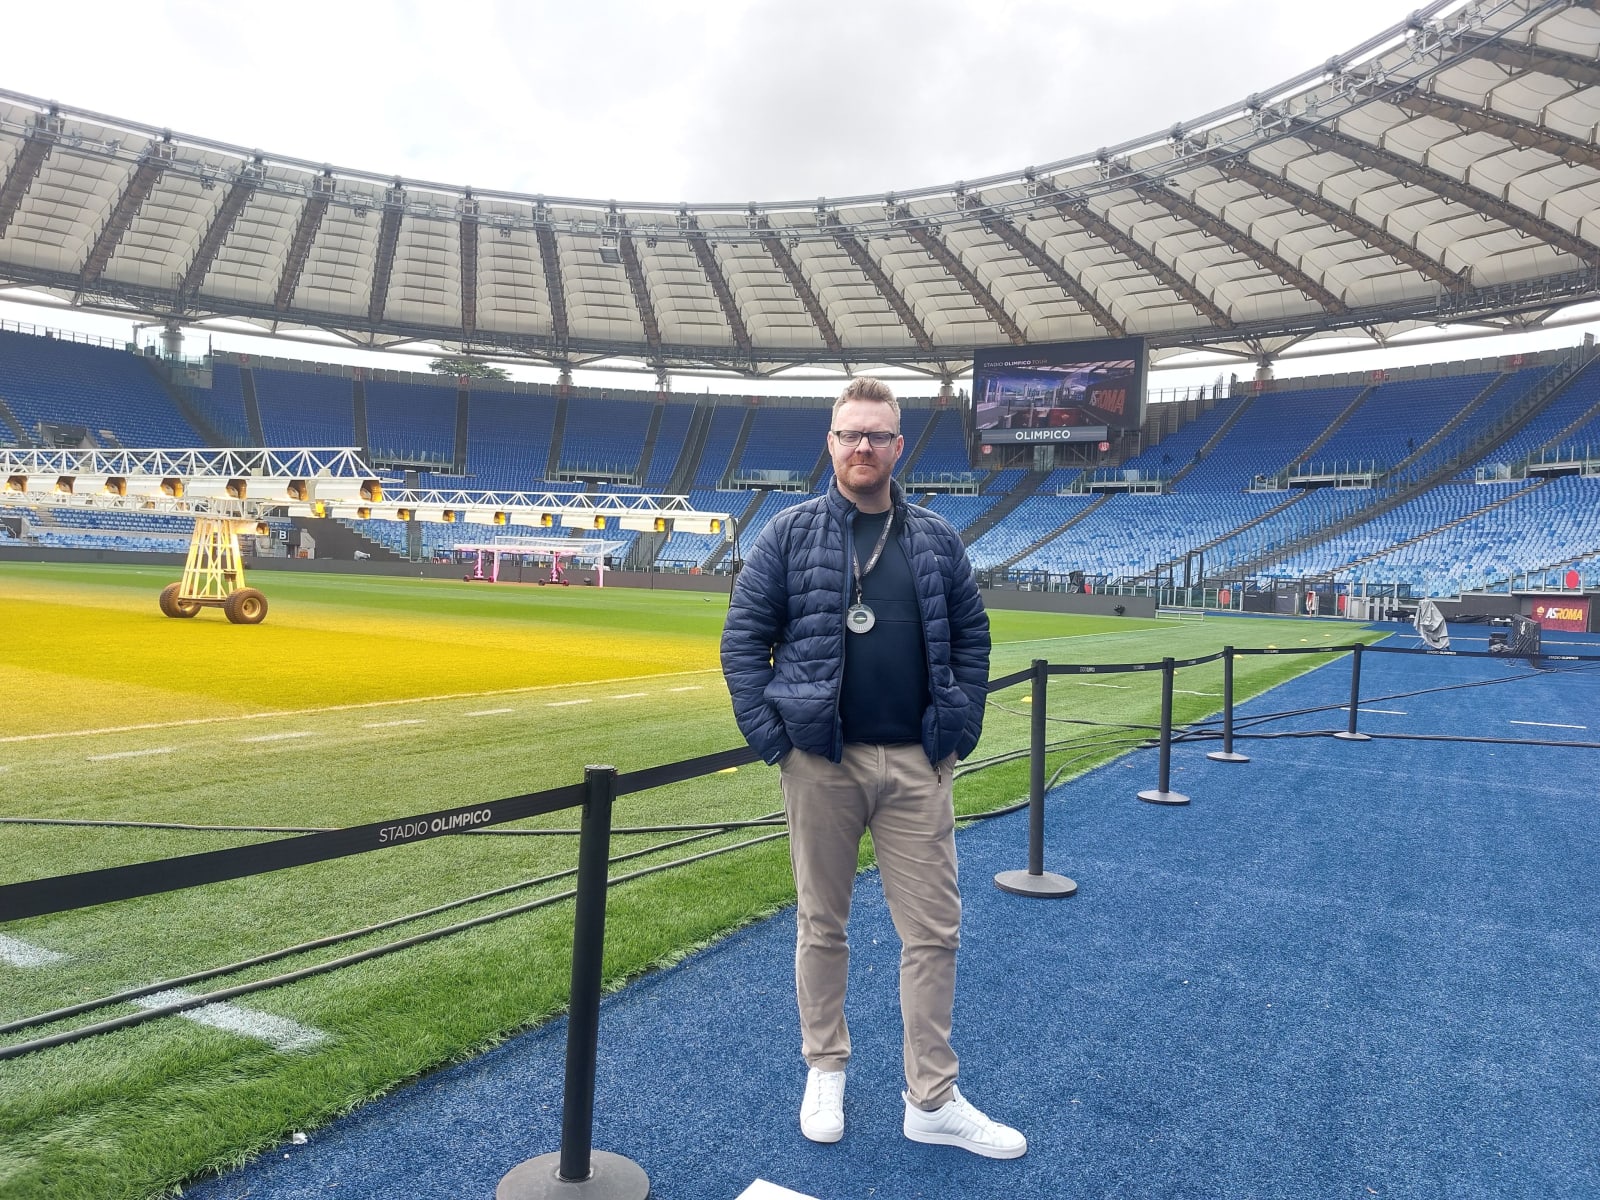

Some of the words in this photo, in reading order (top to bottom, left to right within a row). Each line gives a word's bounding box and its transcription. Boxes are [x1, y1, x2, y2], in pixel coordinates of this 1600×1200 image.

[1015, 430, 1071, 440] OLIMPICO
[379, 821, 428, 843] STADIO
[431, 809, 492, 832] OLIMPICO
